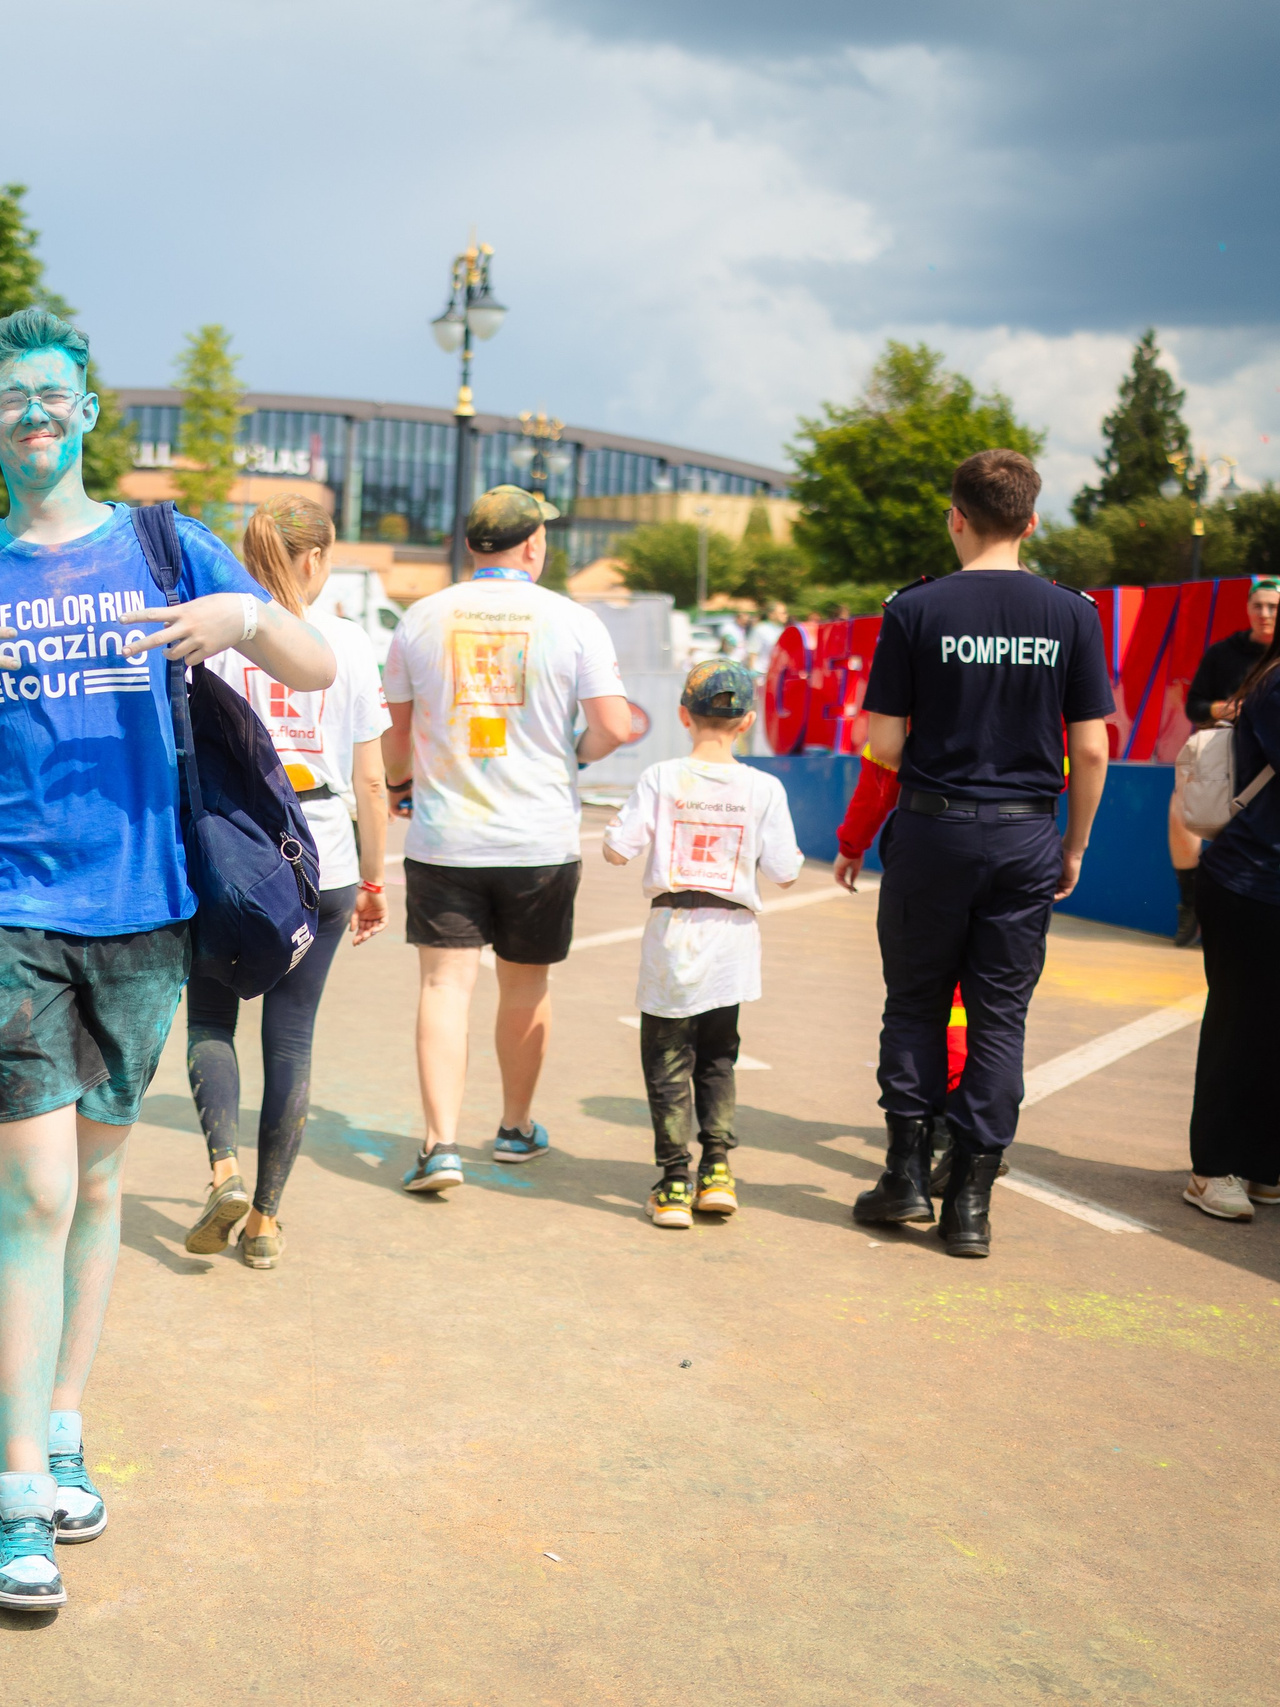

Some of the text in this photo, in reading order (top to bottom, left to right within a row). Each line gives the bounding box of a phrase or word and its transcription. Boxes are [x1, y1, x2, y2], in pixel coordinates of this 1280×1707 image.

[16, 594, 96, 630] COLOR
[98, 590, 146, 622] RUN
[1, 672, 80, 701] tour
[686, 801, 746, 813] UniCredit Bank
